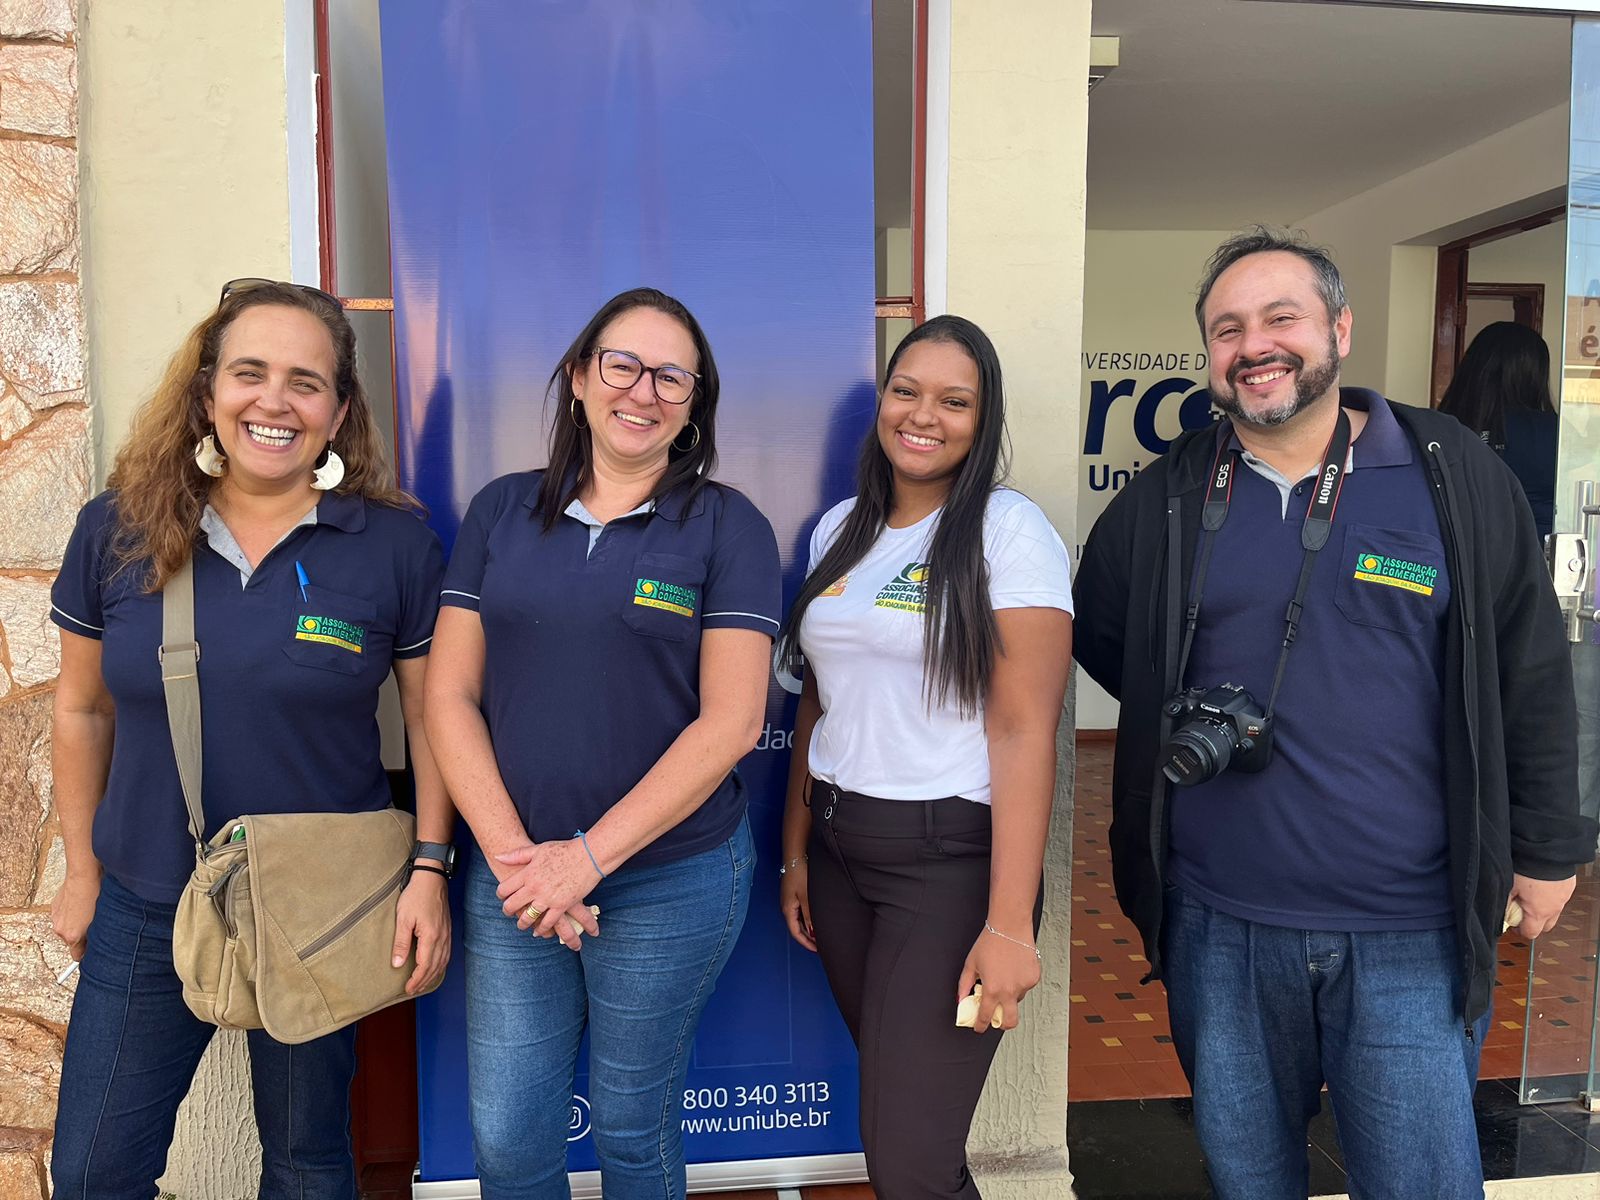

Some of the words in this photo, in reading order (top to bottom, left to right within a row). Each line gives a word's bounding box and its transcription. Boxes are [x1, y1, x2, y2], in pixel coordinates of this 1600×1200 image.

[1194, 353, 1207, 371] D
[1216, 463, 1230, 488] EOS
[1318, 463, 1338, 505] Canon
[1382, 566, 1435, 588] COMERCIAL
[1383, 557, 1438, 578] ASSOCIAÇÃO
[680, 1087, 728, 1110] 800
[734, 1084, 777, 1107] 340
[784, 1081, 830, 1104] 3113
